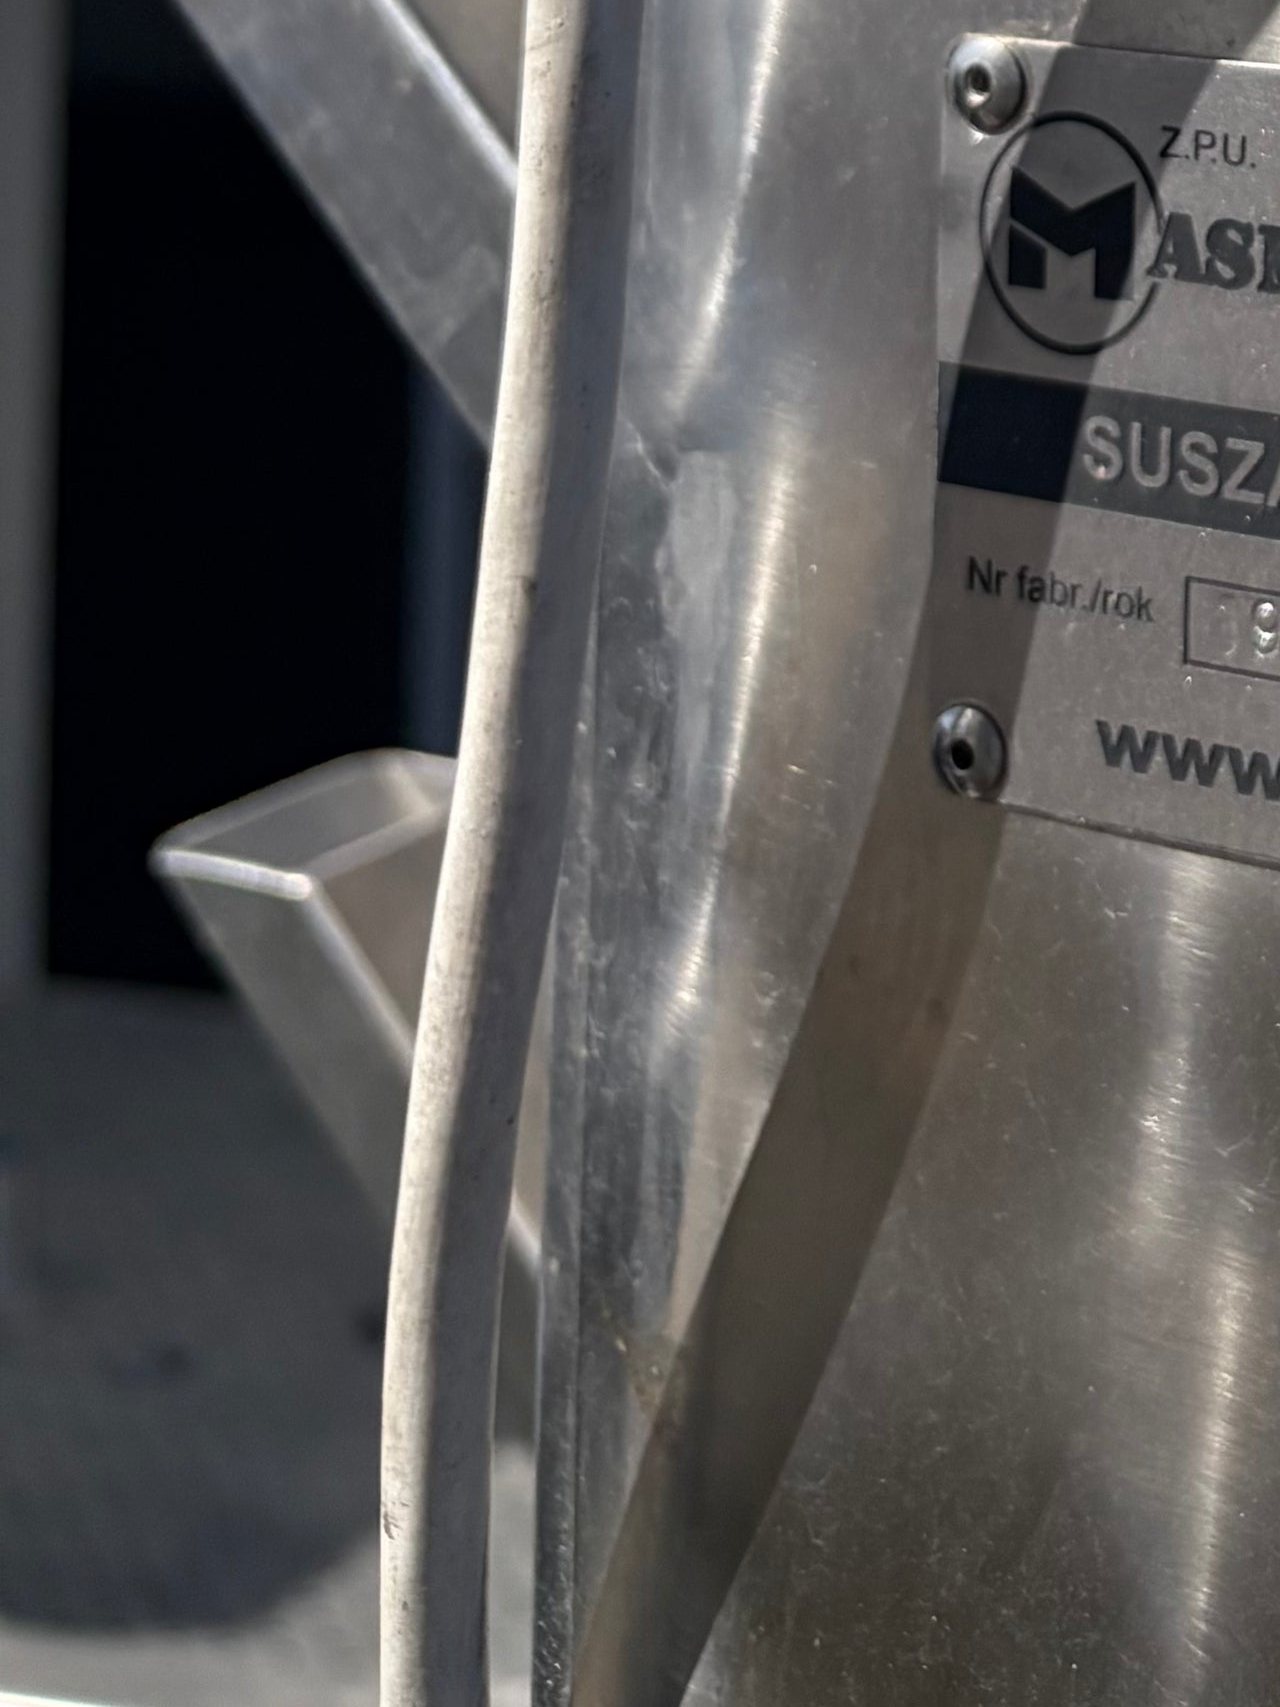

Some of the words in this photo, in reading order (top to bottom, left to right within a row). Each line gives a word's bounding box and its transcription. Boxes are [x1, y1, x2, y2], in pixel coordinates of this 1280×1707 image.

[1159, 125, 1257, 170] Z.P.U.
[967, 555, 1007, 598] Nr
[1016, 563, 1155, 624] fabr./rok
